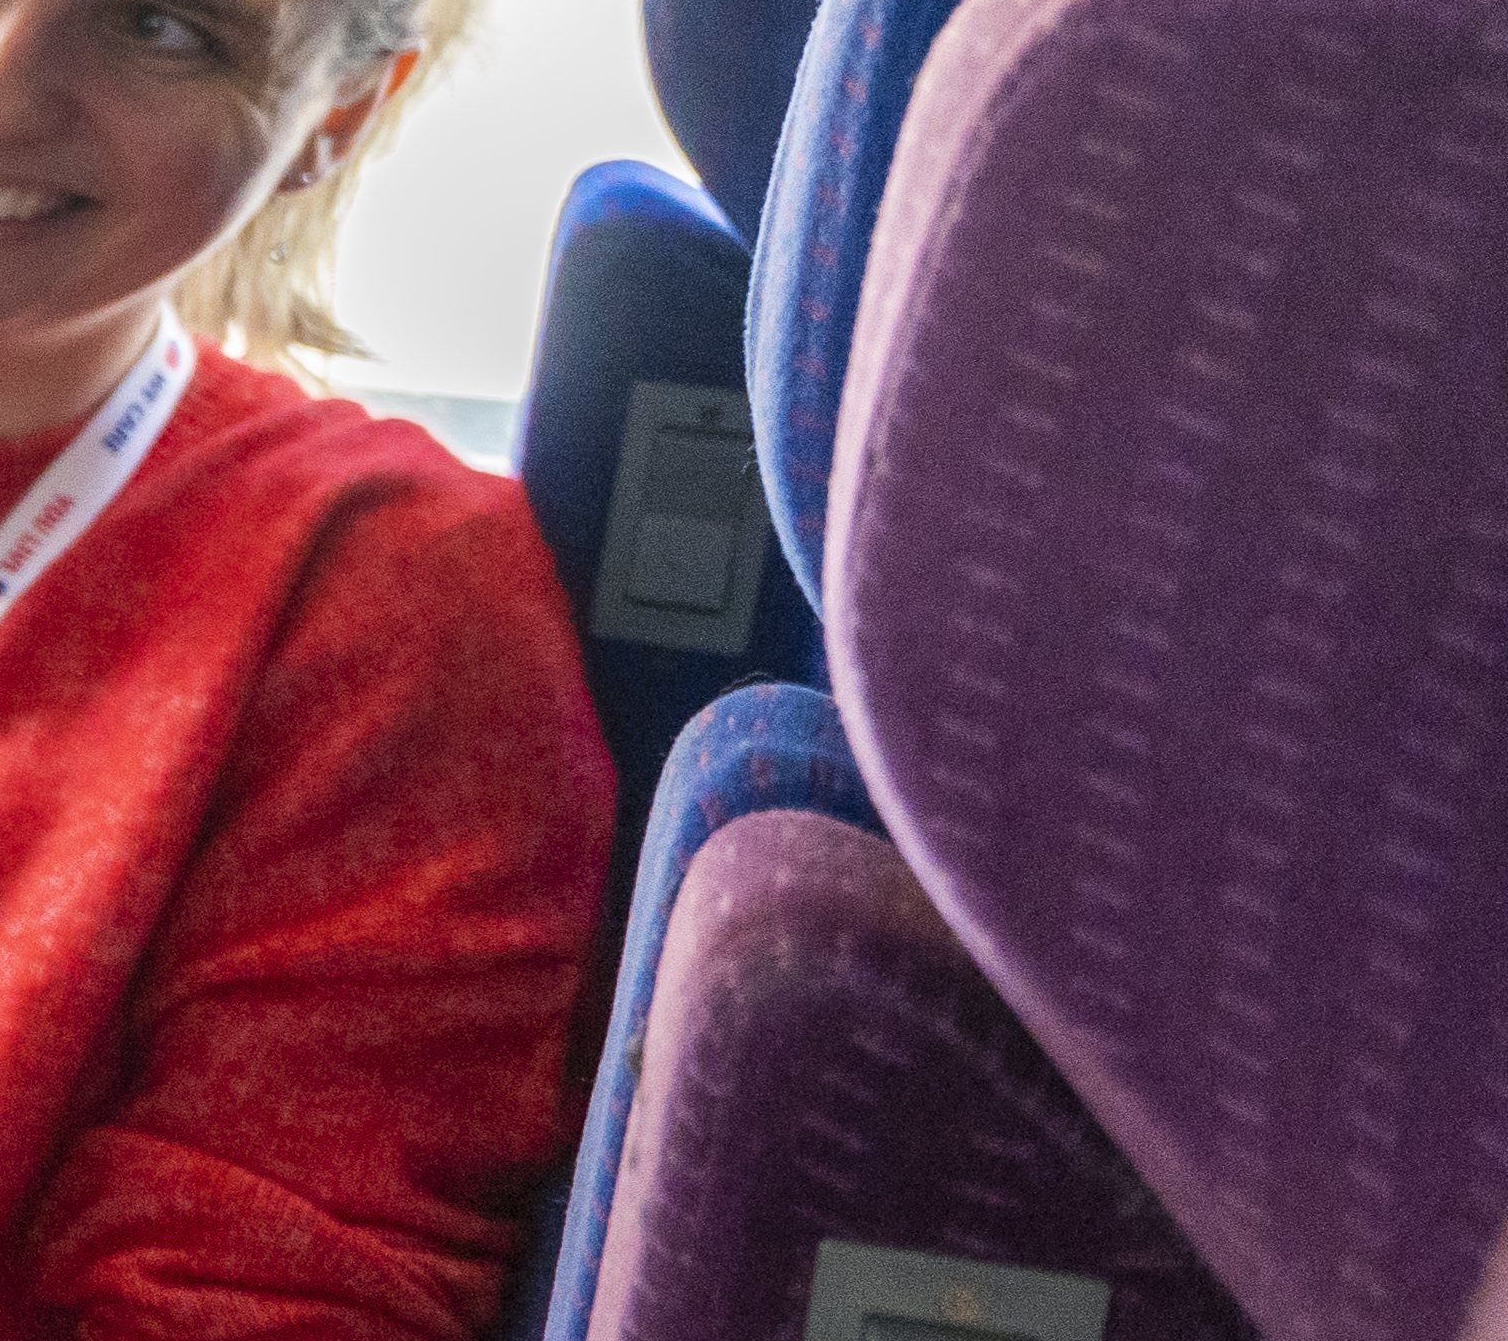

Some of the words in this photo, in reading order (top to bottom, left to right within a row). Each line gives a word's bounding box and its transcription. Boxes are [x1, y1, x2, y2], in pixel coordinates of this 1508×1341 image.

[140, 372, 166, 403] WE
[100, 401, 145, 453] CARE
[32, 493, 76, 535] YOU
[0, 530, 41, 574] LIVE
